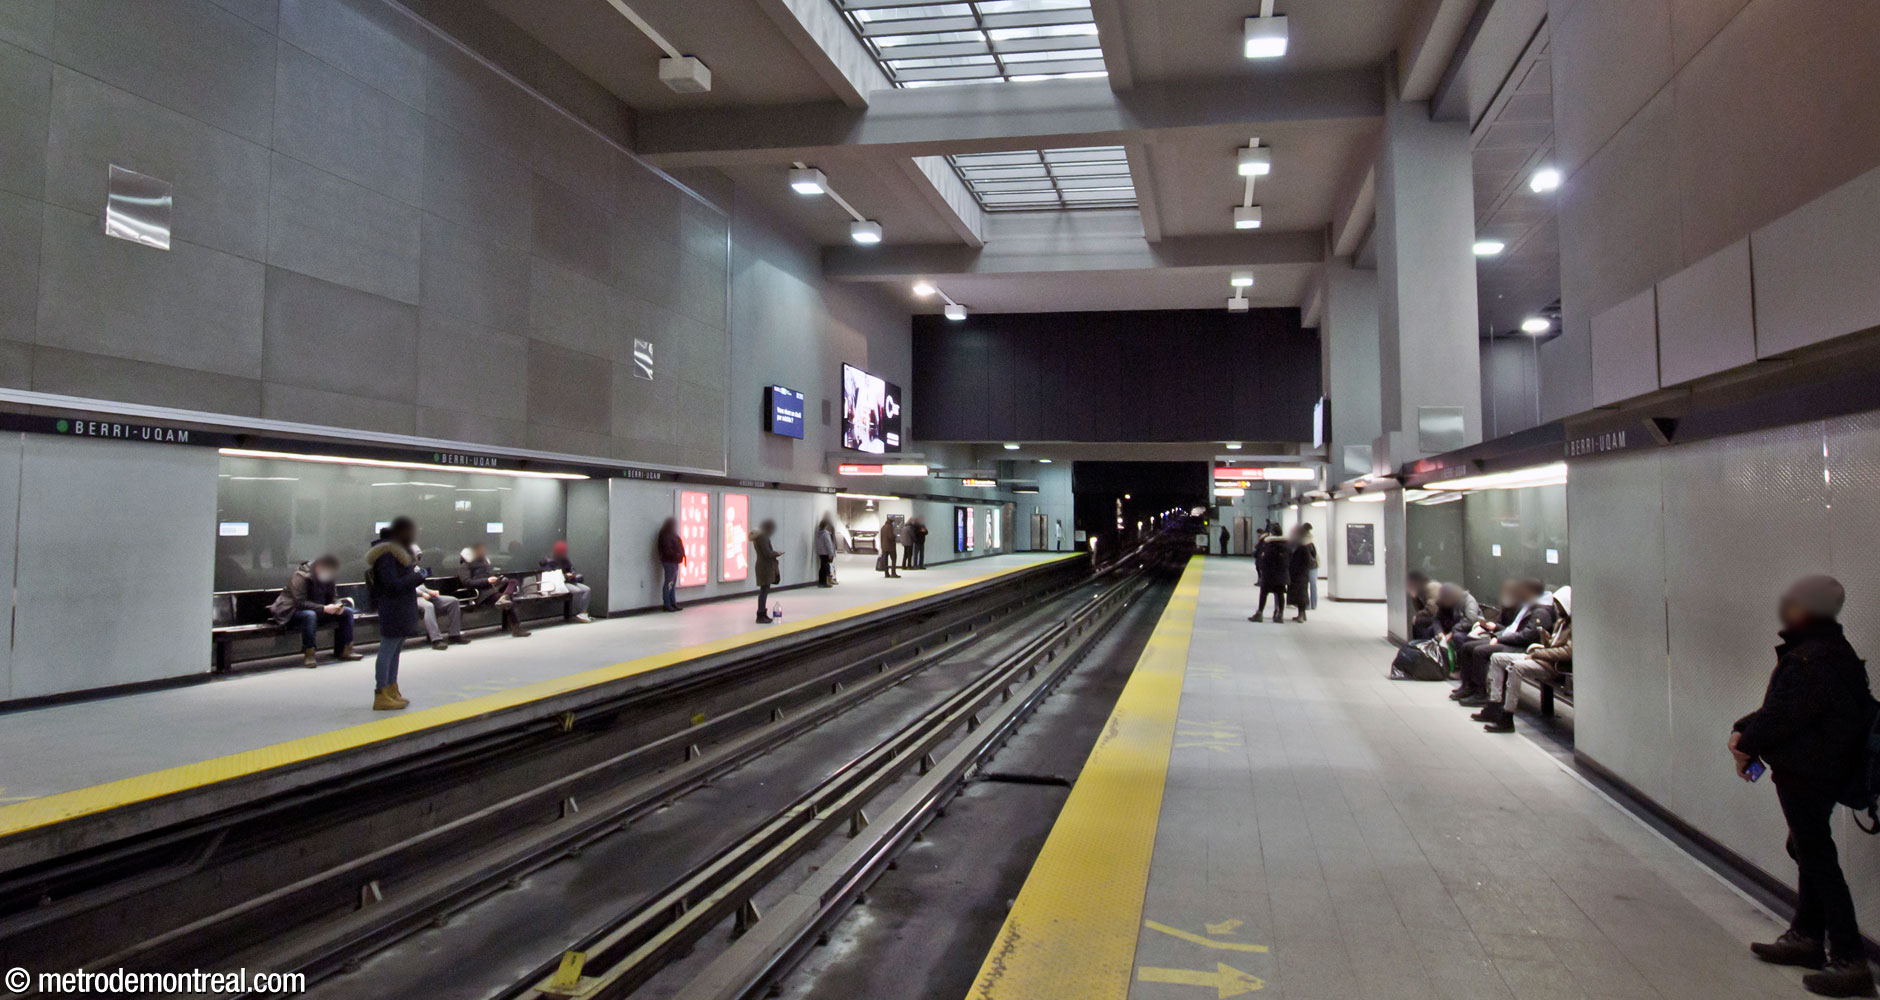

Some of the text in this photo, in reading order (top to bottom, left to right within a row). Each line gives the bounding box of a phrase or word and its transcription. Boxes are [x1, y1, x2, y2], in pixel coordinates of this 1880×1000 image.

[75, 421, 189, 442] BERRI-UQAM
[1571, 431, 1626, 456] BERRI-UQAM
[442, 453, 497, 466] BERRI-UQAM
[628, 470, 661, 480] BERRI-UQAM
